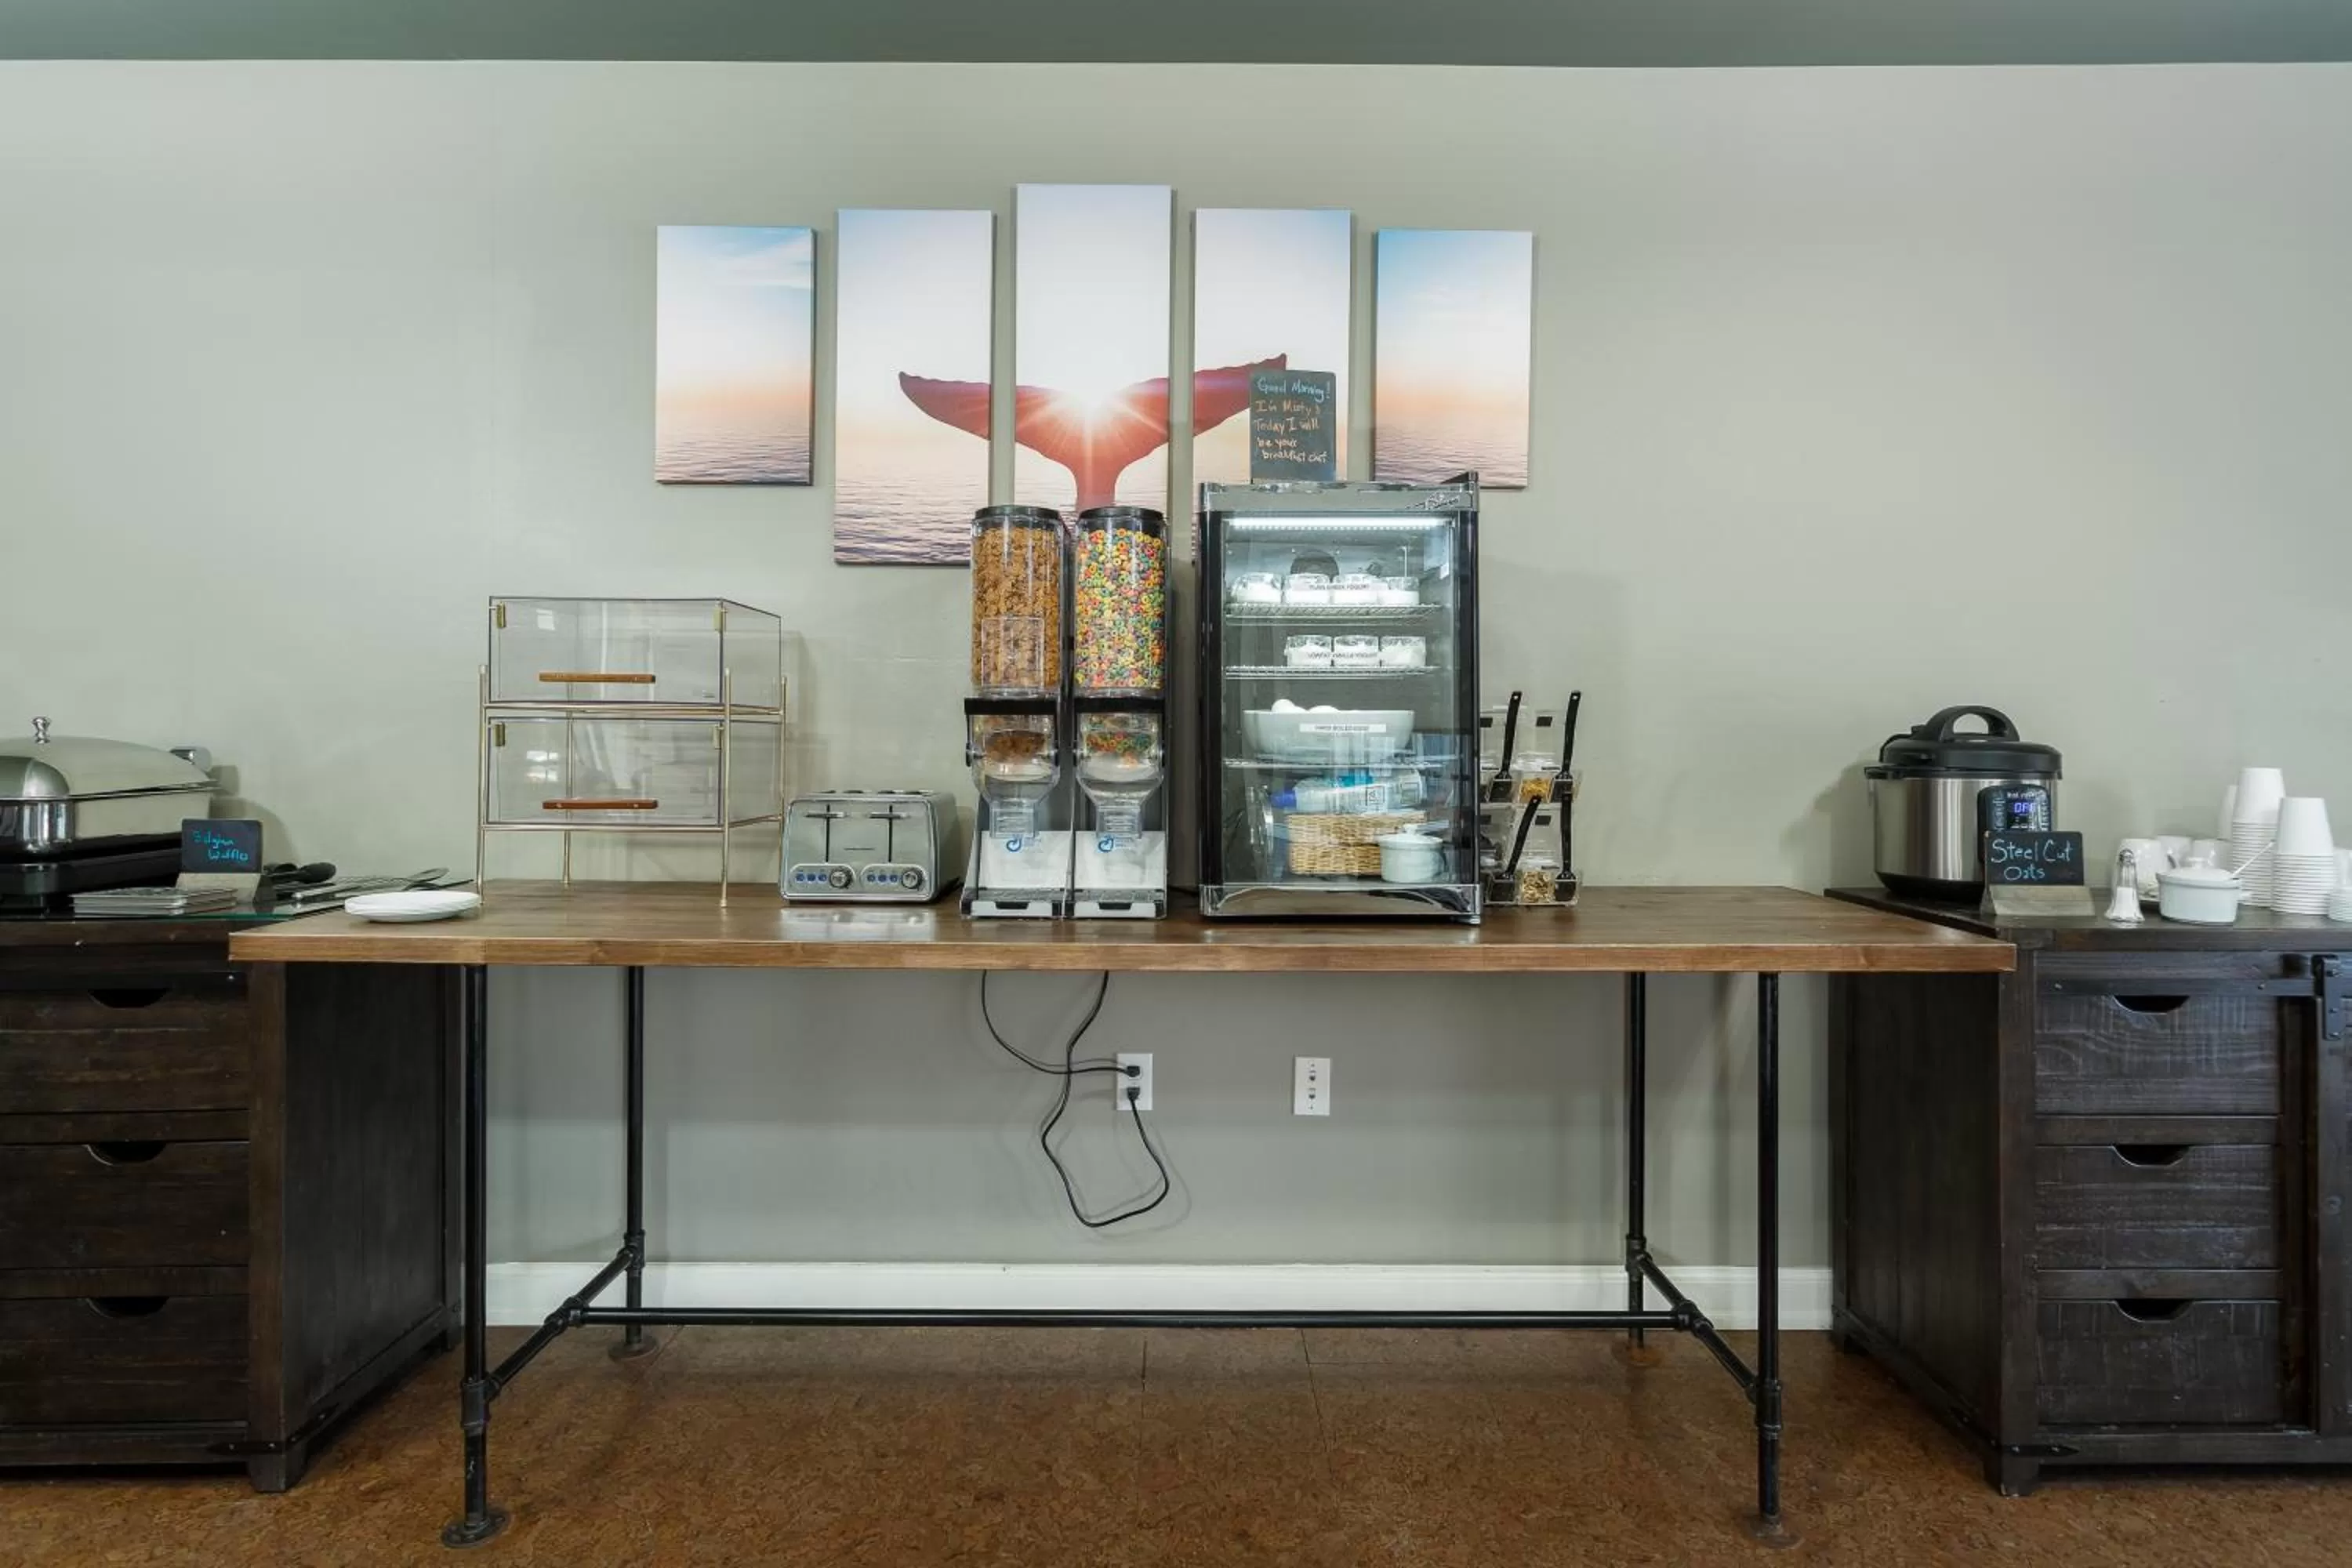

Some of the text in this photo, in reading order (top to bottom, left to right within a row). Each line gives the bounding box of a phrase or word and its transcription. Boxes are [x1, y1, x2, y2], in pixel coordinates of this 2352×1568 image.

[1257, 376, 1287, 394] Good
[1254, 418, 1286, 435] Today
[1286, 416, 1298, 432] I
[1257, 437, 1298, 450] be your
[1991, 838, 2073, 863] Steel Cut
[2004, 863, 2045, 881] Oats
